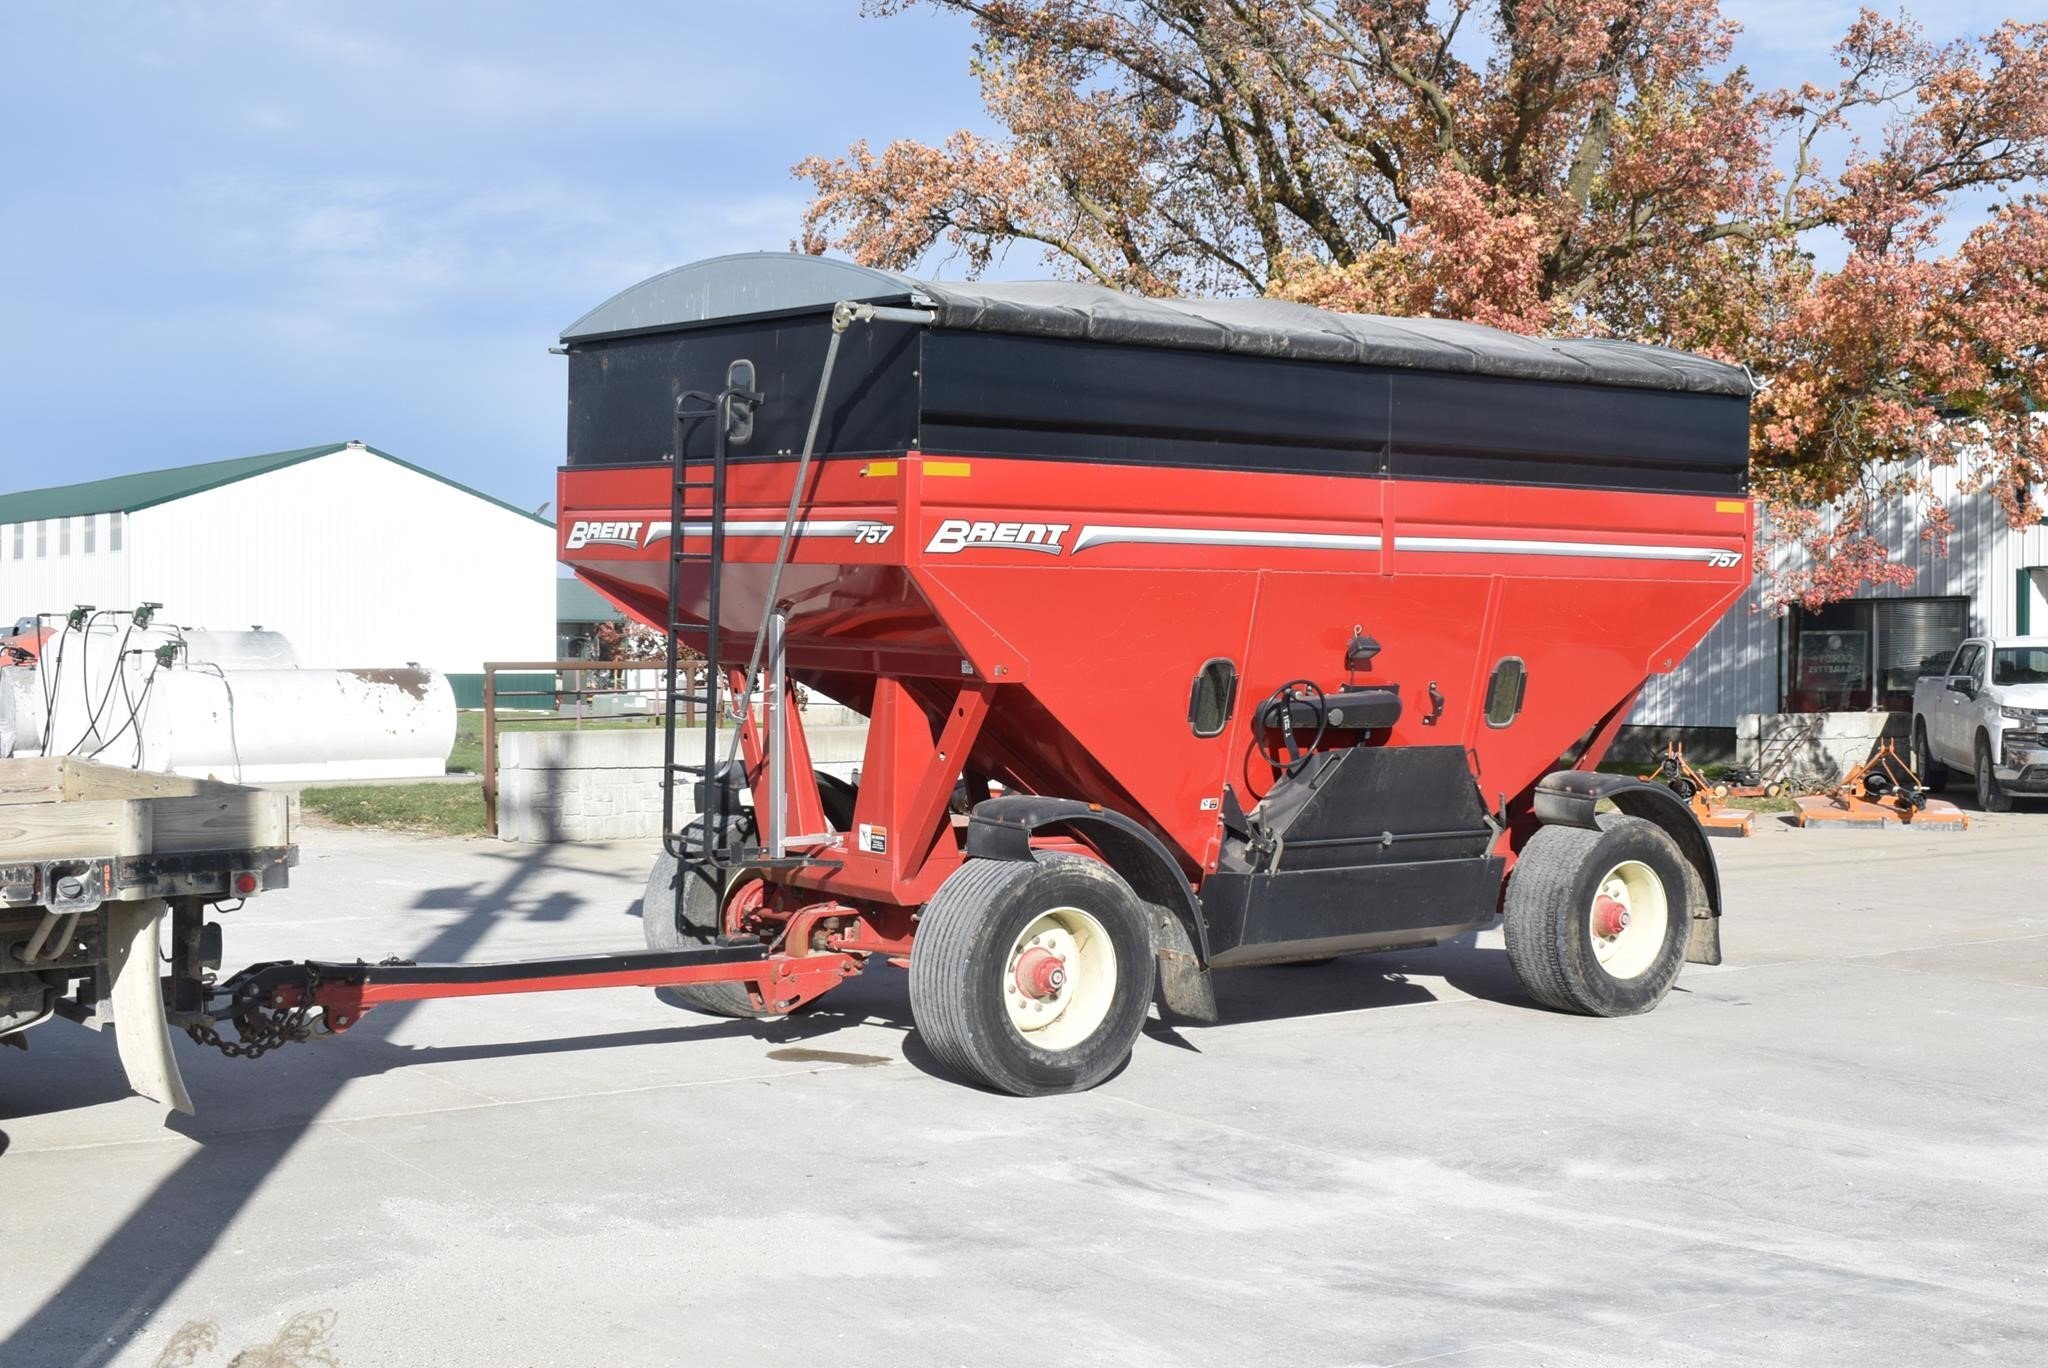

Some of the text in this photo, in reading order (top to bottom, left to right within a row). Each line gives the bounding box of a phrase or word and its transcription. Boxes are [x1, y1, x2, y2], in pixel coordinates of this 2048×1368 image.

[566, 521, 643, 549] BRENT
[854, 525, 894, 544] 757
[924, 519, 1071, 553] BRENT
[1708, 553, 1743, 568] 757
